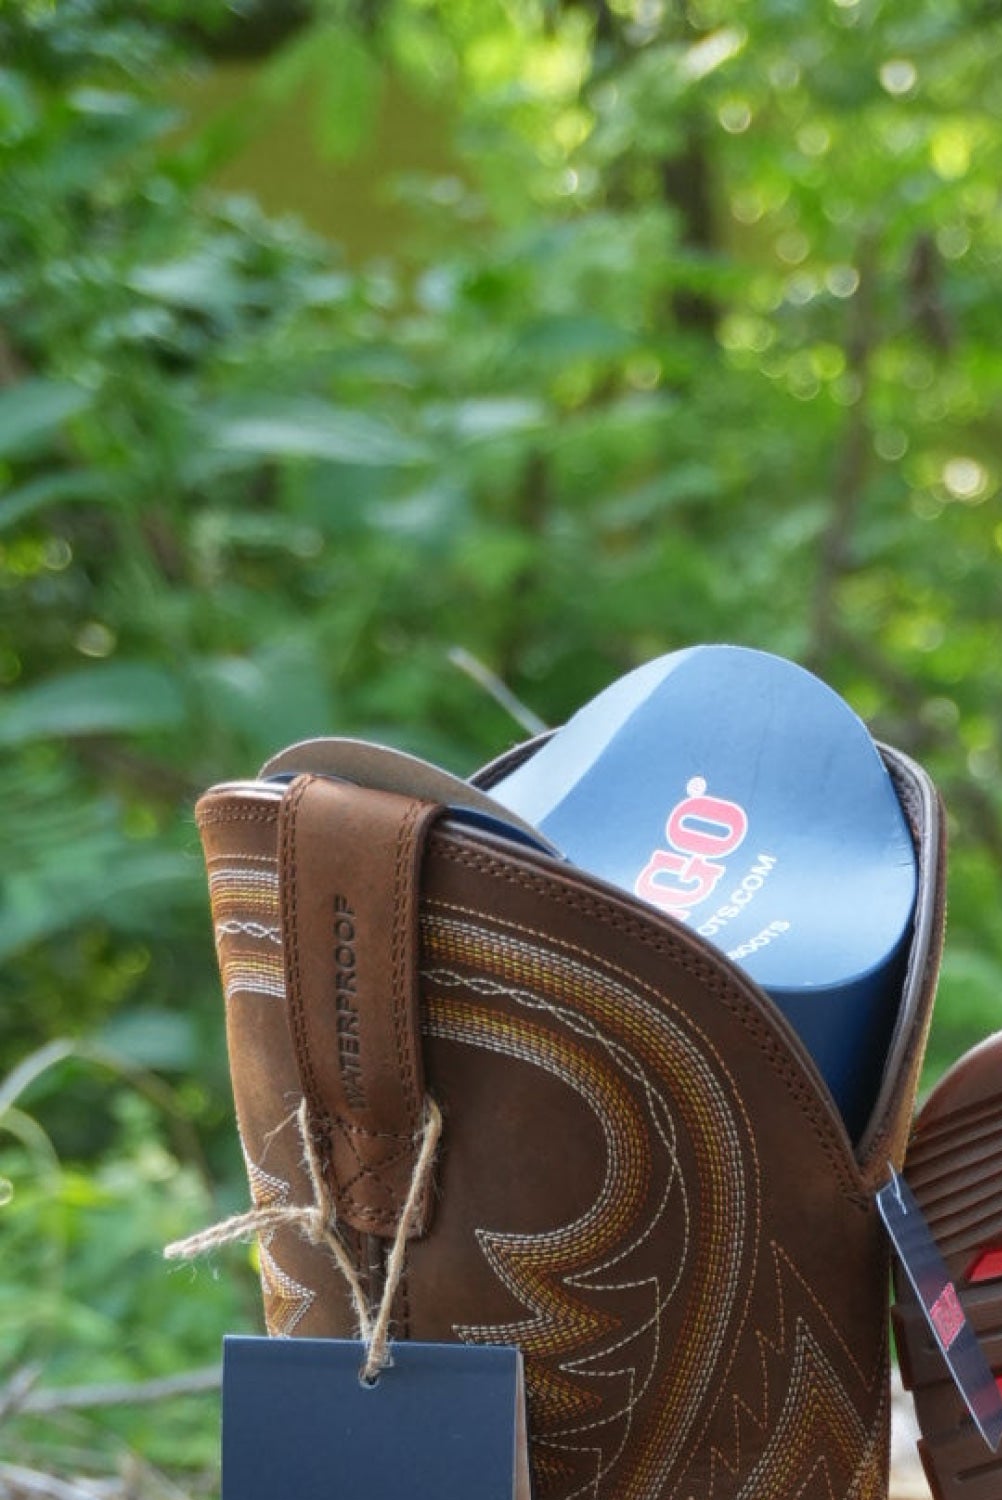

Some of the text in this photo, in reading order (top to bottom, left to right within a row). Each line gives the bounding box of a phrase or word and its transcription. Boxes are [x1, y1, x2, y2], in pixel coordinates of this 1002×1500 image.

[634, 796, 748, 921] GO
[697, 854, 777, 936] OTS.COM
[333, 893, 368, 1112] WATERPROOF
